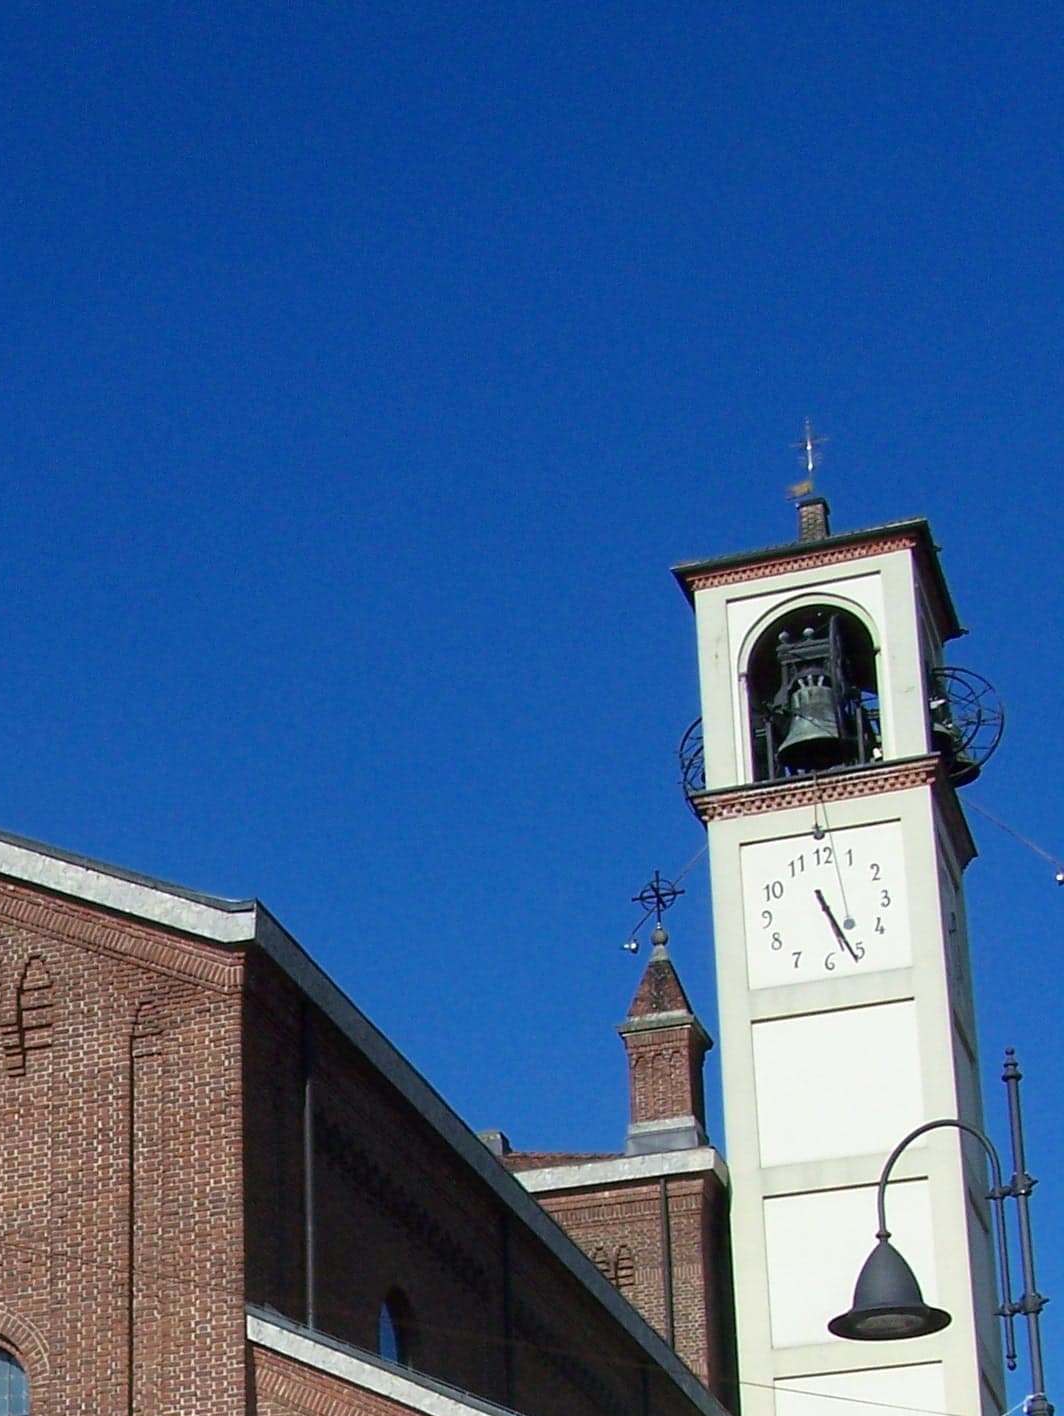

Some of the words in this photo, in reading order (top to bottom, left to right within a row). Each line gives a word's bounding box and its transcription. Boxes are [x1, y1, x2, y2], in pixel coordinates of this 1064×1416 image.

[813, 847, 833, 866] 12
[845, 849, 853, 866] 1
[788, 855, 805, 877] 11
[870, 863, 881, 881] 2
[763, 881, 784, 902] 10
[881, 890, 891, 908] 3
[761, 910, 773, 929] 9
[875, 917, 885, 935] 4
[771, 932, 783, 950] 8
[792, 952, 802, 969] 7
[855, 942, 865, 961] 5
[824, 953, 835, 971] 6
